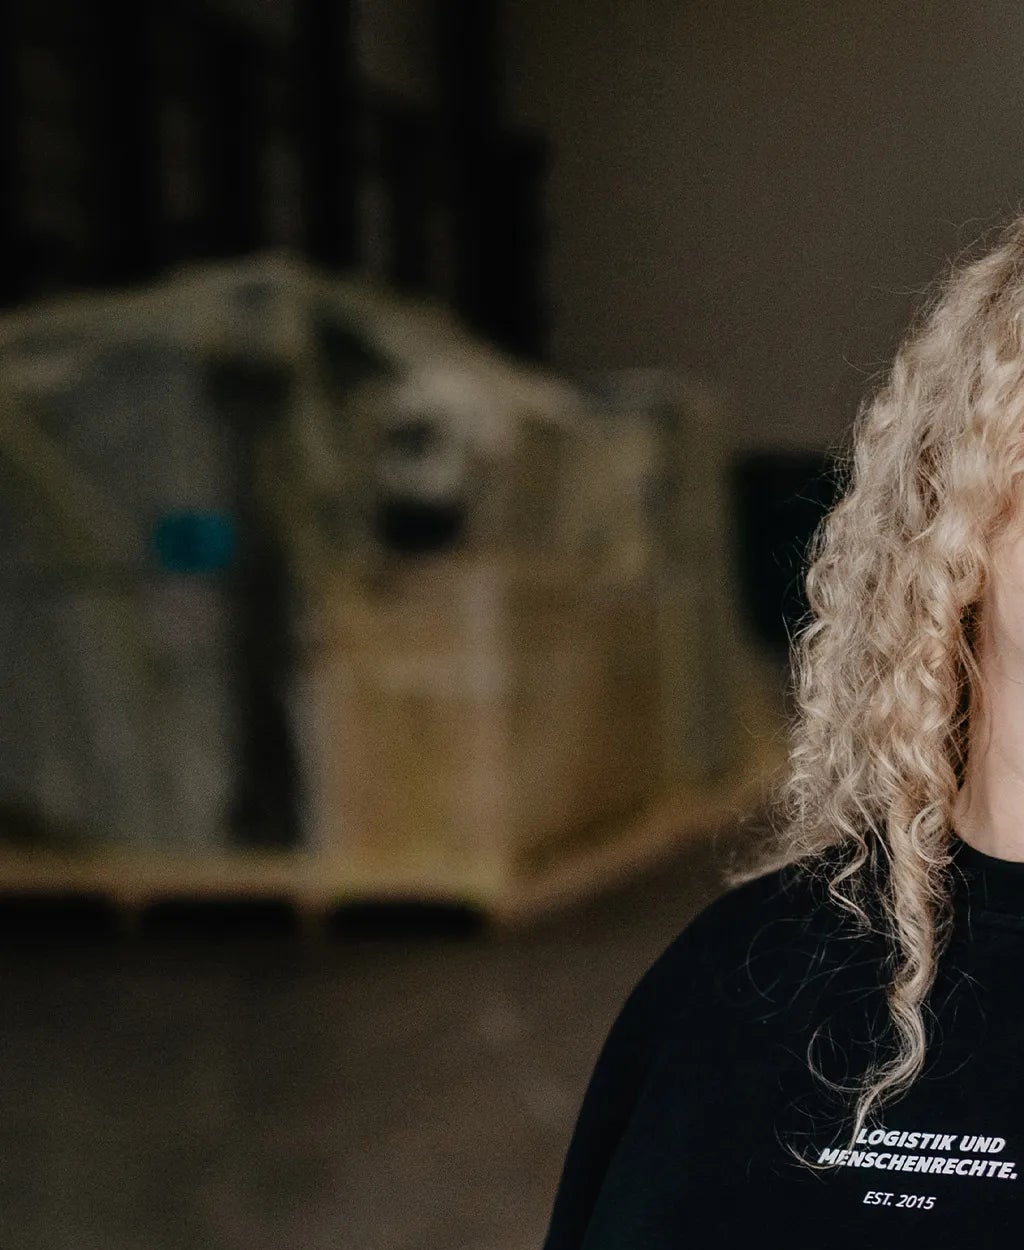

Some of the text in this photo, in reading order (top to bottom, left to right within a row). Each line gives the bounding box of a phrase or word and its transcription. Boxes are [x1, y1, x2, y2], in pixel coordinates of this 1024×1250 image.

[855, 1128, 1006, 1154] LOGISTIK UND
[817, 1148, 1018, 1180] MENSCHENRECHTE.
[863, 1191, 936, 1210] EST. 2015
